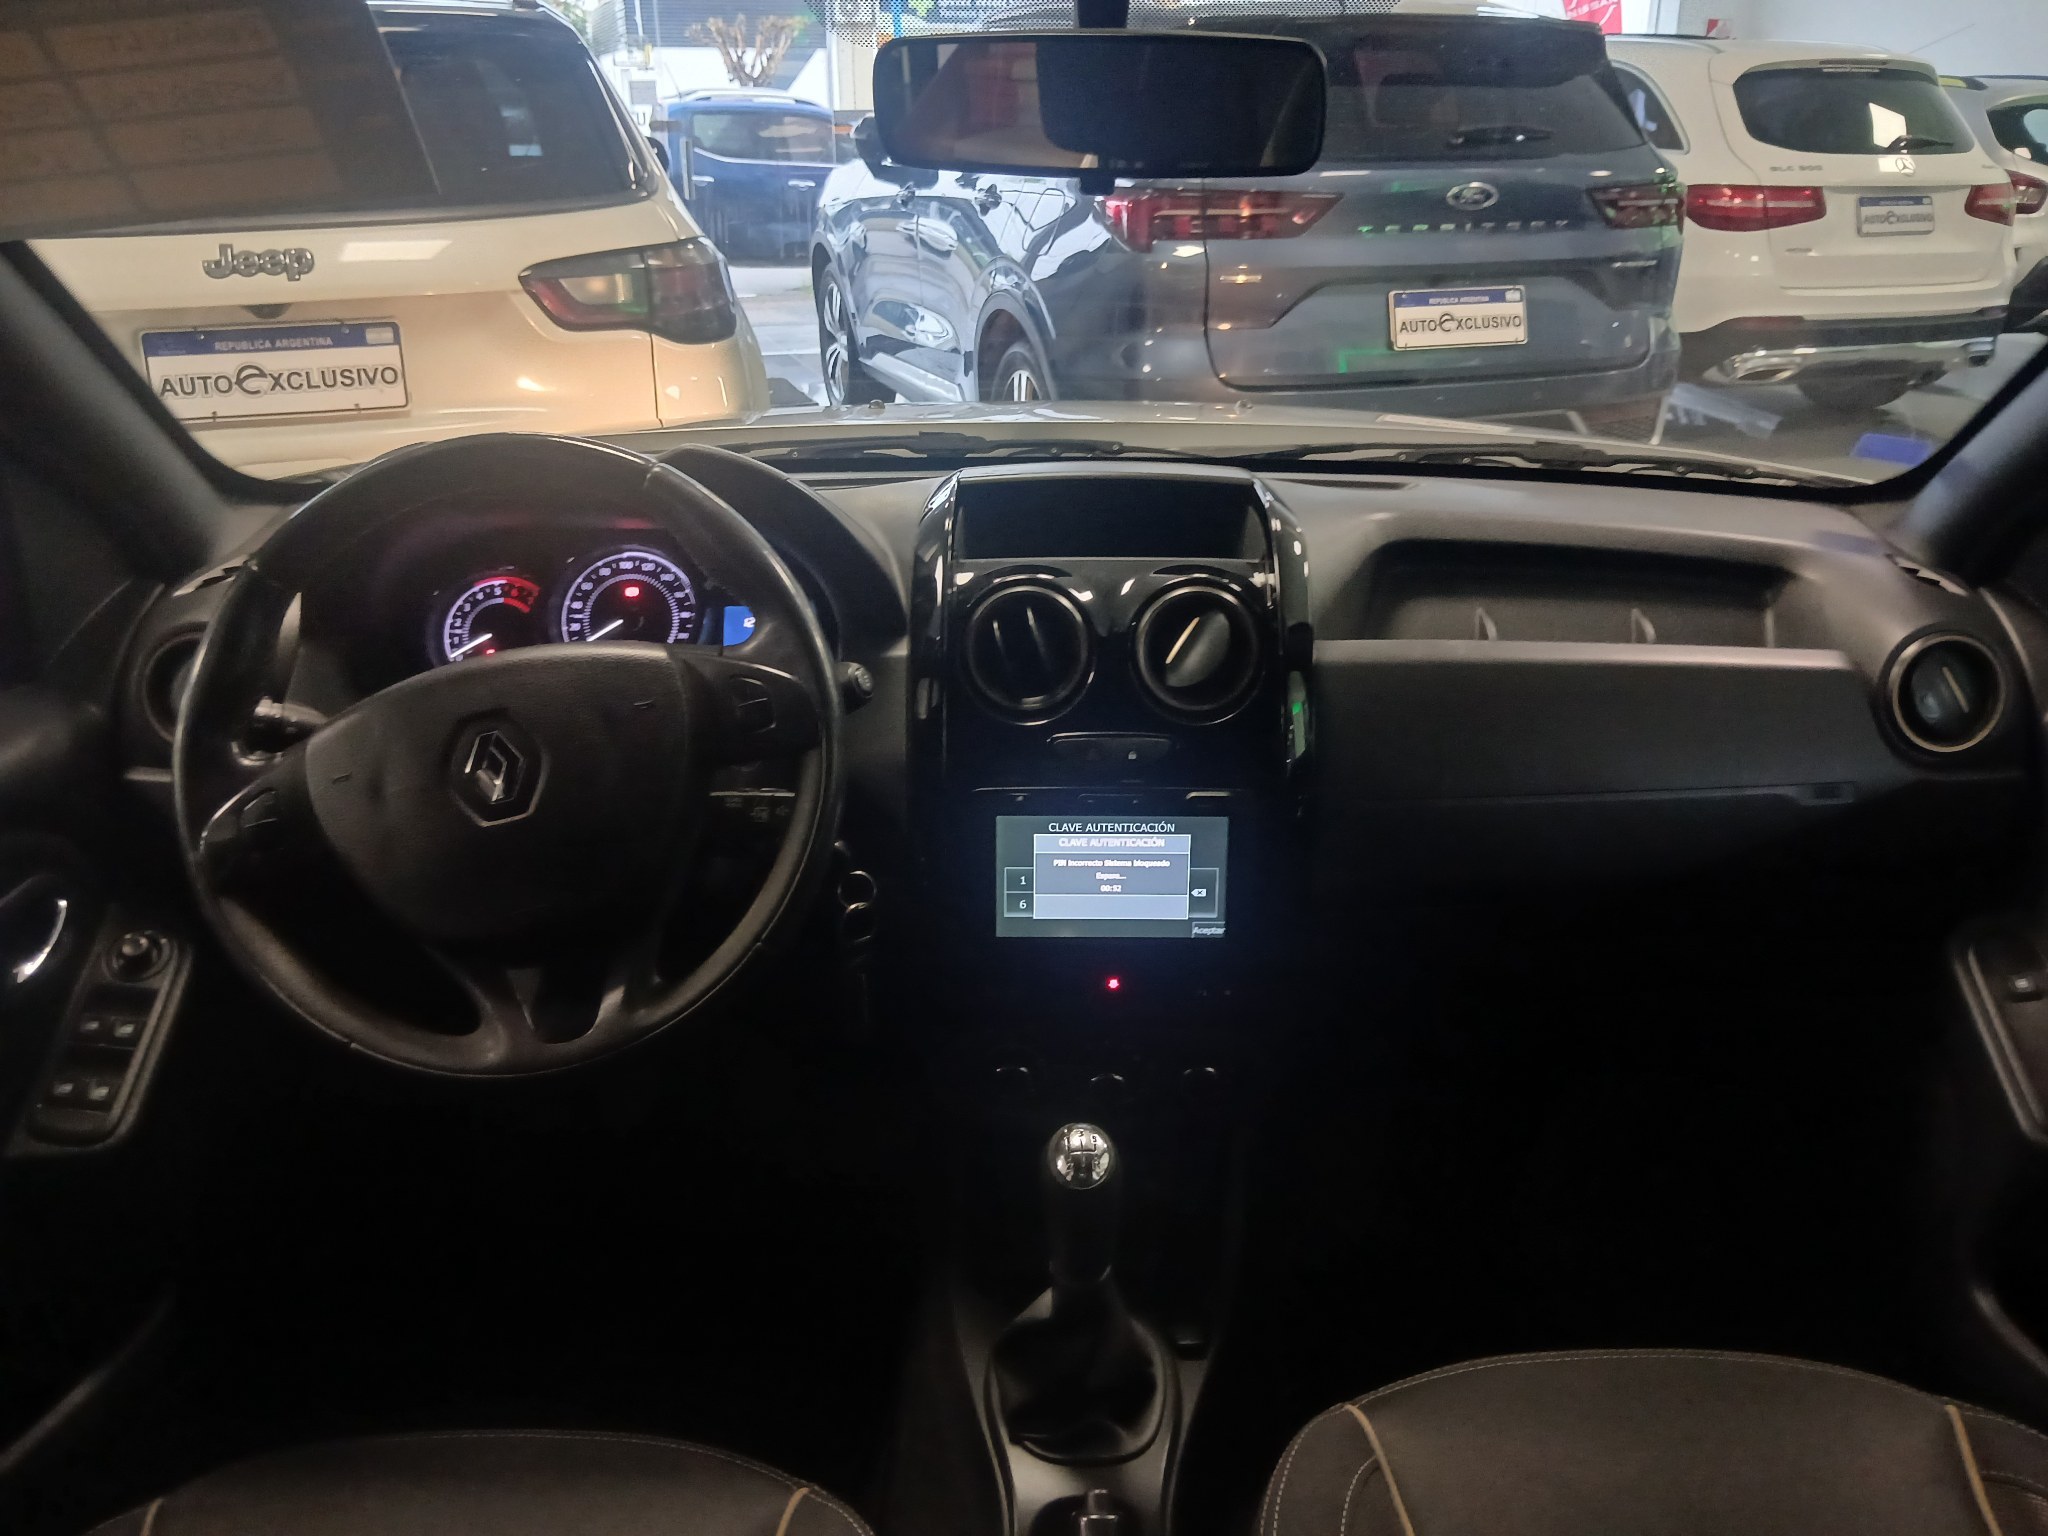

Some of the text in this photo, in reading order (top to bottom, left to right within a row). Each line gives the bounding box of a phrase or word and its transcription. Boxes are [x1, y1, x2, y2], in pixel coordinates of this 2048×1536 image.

[202, 243, 315, 281] Jeep
[1048, 821, 1175, 833] CLAVE AUTENTICACIÓN
[1058, 837, 1088, 847] CLAVE
[1020, 876, 1027, 885] 1
[1019, 899, 1027, 909] 6
